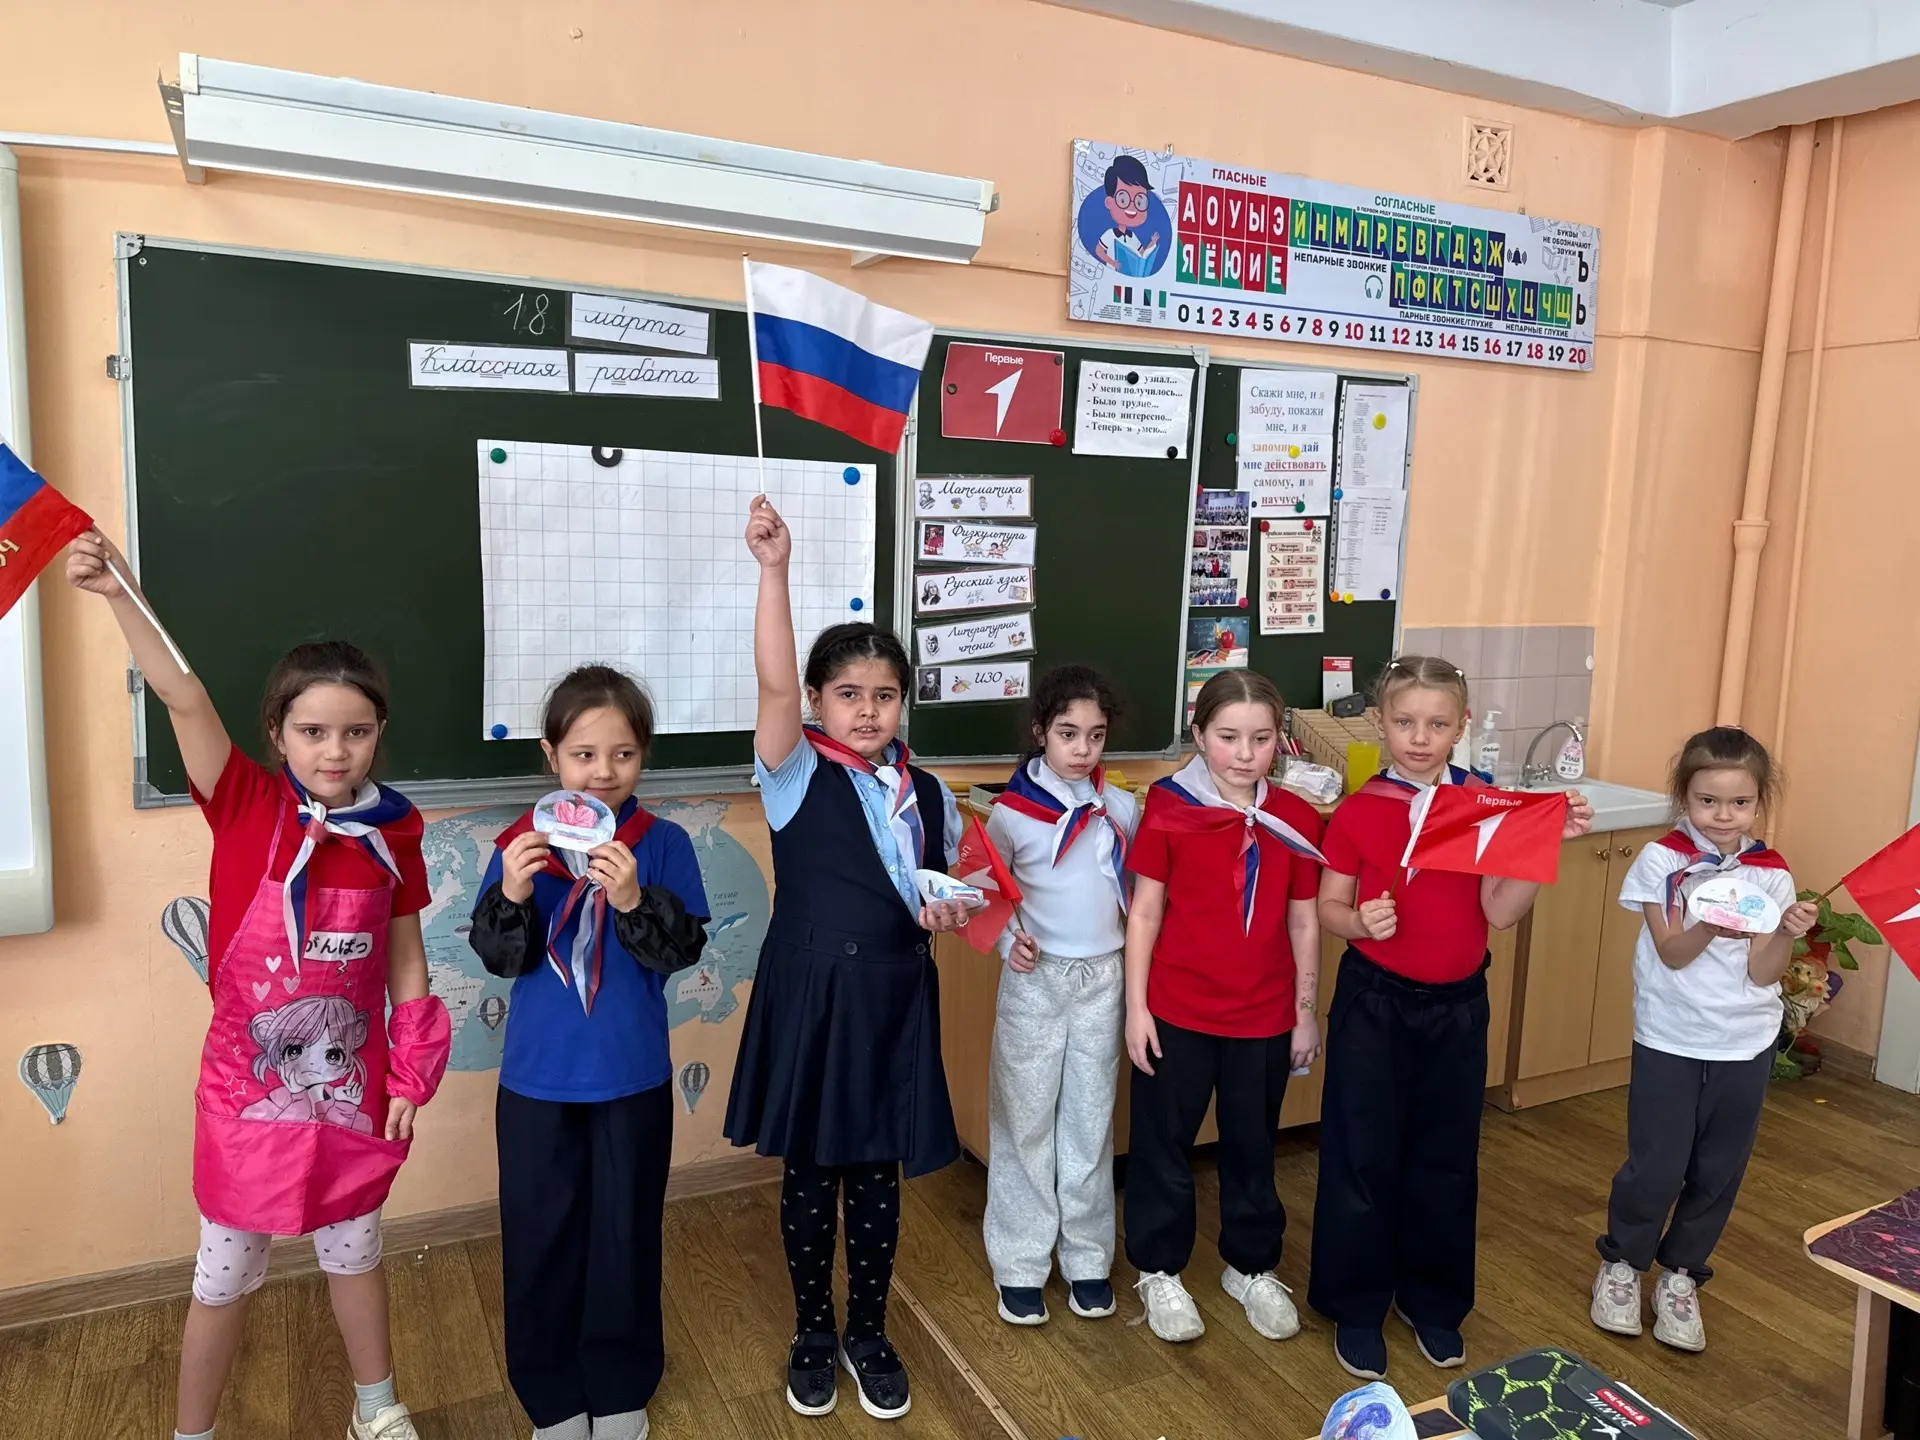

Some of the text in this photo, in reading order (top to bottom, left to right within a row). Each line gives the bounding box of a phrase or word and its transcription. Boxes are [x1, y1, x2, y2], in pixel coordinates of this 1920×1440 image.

[1212, 168, 1267, 187] ГЛАСНЫЕ
[1374, 195, 1436, 215] СОГЛАСНЫЕ
[1557, 229, 1579, 238] БУКВЫ
[1542, 236, 1591, 249] НЕ ОБОЗНАЧАЮТ
[1556, 247, 1577, 256] ЗВУКИ
[1294, 252, 1387, 273] НЕПАРНЫЕ ЗВОНКИЕ
[503, 293, 549, 335] 18
[1399, 310, 1431, 321] ПАРНЫЕ
[1177, 304, 1190, 323] 0
[1196, 306, 1205, 324] 1
[1212, 307, 1222, 326] 2
[1229, 309, 1240, 328] 3
[1245, 312, 1257, 330] 4
[1263, 313, 1274, 332] 5
[1280, 315, 1291, 333] 6
[1297, 317, 1307, 334] 7
[1312, 318, 1323, 337] 8
[1328, 320, 1340, 337] 9
[1345, 322, 1364, 341] 10
[1369, 325, 1386, 343] 11
[1392, 327, 1410, 345] 12
[1415, 330, 1433, 348] 13
[1438, 332, 1457, 350] 14
[1462, 335, 1479, 353] 15
[1484, 338, 1501, 355] 16
[1506, 340, 1523, 357] 17
[1527, 343, 1543, 360] 18
[1548, 345, 1564, 362] 19
[1568, 347, 1586, 364] 20
[1505, 323, 1569, 338] НЕПАРНЫЕ ГЛУХИЕ
[984, 352, 1024, 365] Первые
[1250, 385, 1325, 400] Скажи мне, и я
[1092, 396, 1117, 405] Было
[1092, 409, 1116, 419] Было
[1248, 403, 1324, 417] забуду, покажи
[1091, 421, 1122, 433] Теперь
[1266, 423, 1307, 434] мне, и я
[1301, 441, 1319, 453] дай
[1242, 459, 1327, 471] мне действовать
[1299, 479, 1305, 487] и
[938, 482, 1024, 498] Математика
[952, 525, 1027, 546] Физкультура
[944, 573, 1028, 596] Русский язык
[948, 620, 1020, 642] Литературное
[958, 641, 996, 654] чтение
[974, 671, 1003, 684] ИЗО
[1476, 794, 1523, 807] Первые
